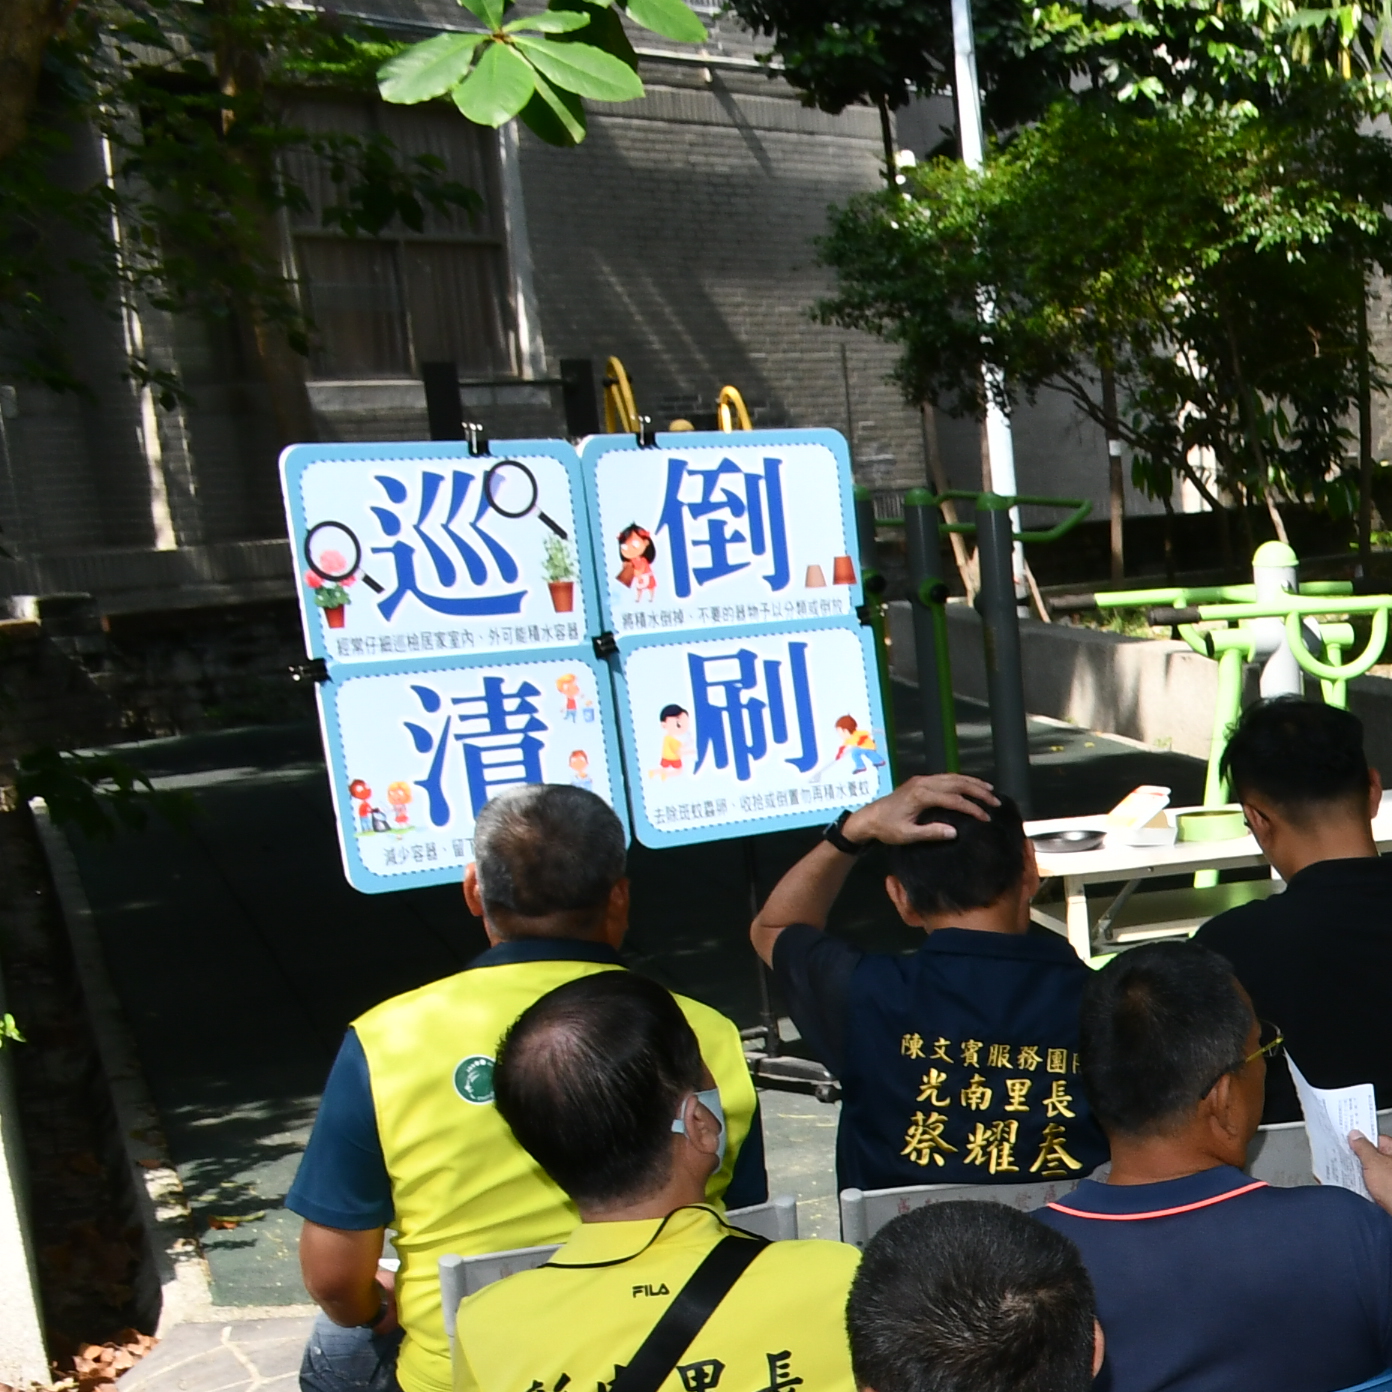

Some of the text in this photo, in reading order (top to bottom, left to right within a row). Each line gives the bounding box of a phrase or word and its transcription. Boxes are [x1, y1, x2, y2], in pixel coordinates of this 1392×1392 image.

[370, 470, 528, 621] 巡
[656, 457, 791, 598] 倒
[405, 676, 548, 826] 清
[687, 642, 819, 781] 刷
[916, 1068, 1076, 1118] 光南里長
[632, 1284, 669, 1298] FILA
